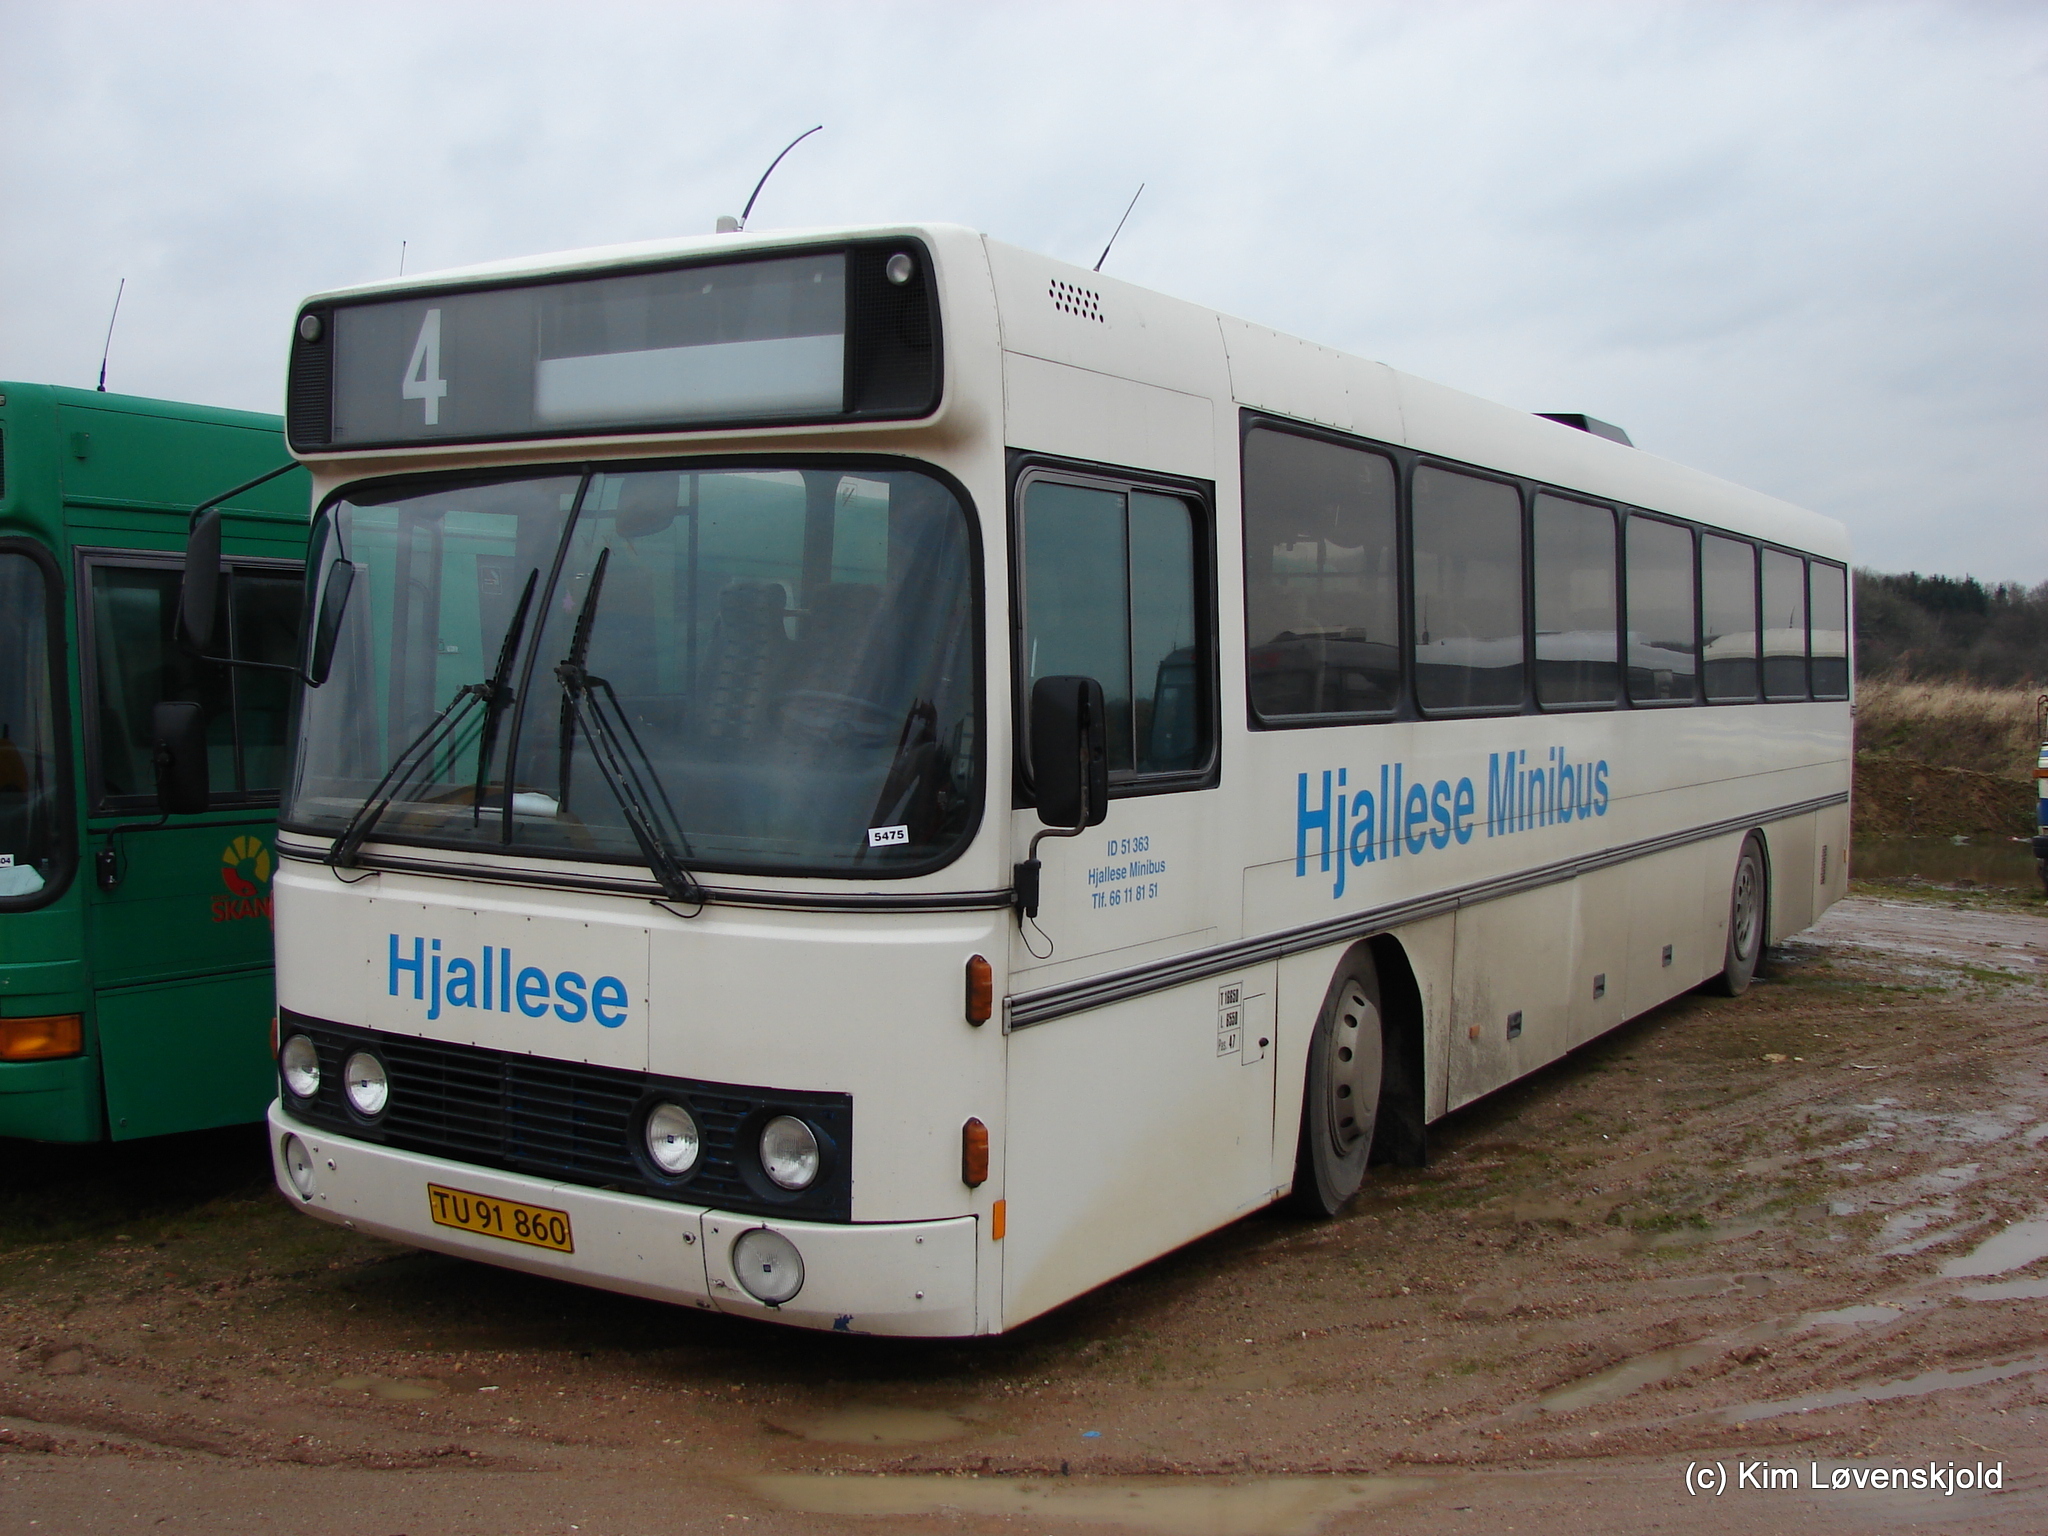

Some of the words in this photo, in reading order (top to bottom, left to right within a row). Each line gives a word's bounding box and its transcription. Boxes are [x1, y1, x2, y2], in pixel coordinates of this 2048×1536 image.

[402, 308, 447, 426] 4
[874, 830, 905, 842] 5475
[1295, 763, 1475, 900] Hjallese
[1487, 746, 1609, 838] Minibus
[1107, 840, 1118, 857] ID
[1088, 866, 1127, 888] Hjallese
[1129, 859, 1166, 878] Minibus
[1091, 892, 1107, 909] Tlf.
[1109, 889, 1121, 906] 66
[1123, 887, 1132, 903] 11
[1136, 884, 1145, 901] 81
[1148, 882, 1158, 898] 51
[211, 896, 272, 923] SKAN
[389, 932, 630, 1028] Hjallese
[1220, 992, 1224, 1006] T
[1228, 1034, 1236, 1049] 47
[433, 1191, 470, 1224] TU
[475, 1200, 503, 1232] 91
[514, 1209, 567, 1245] 860
